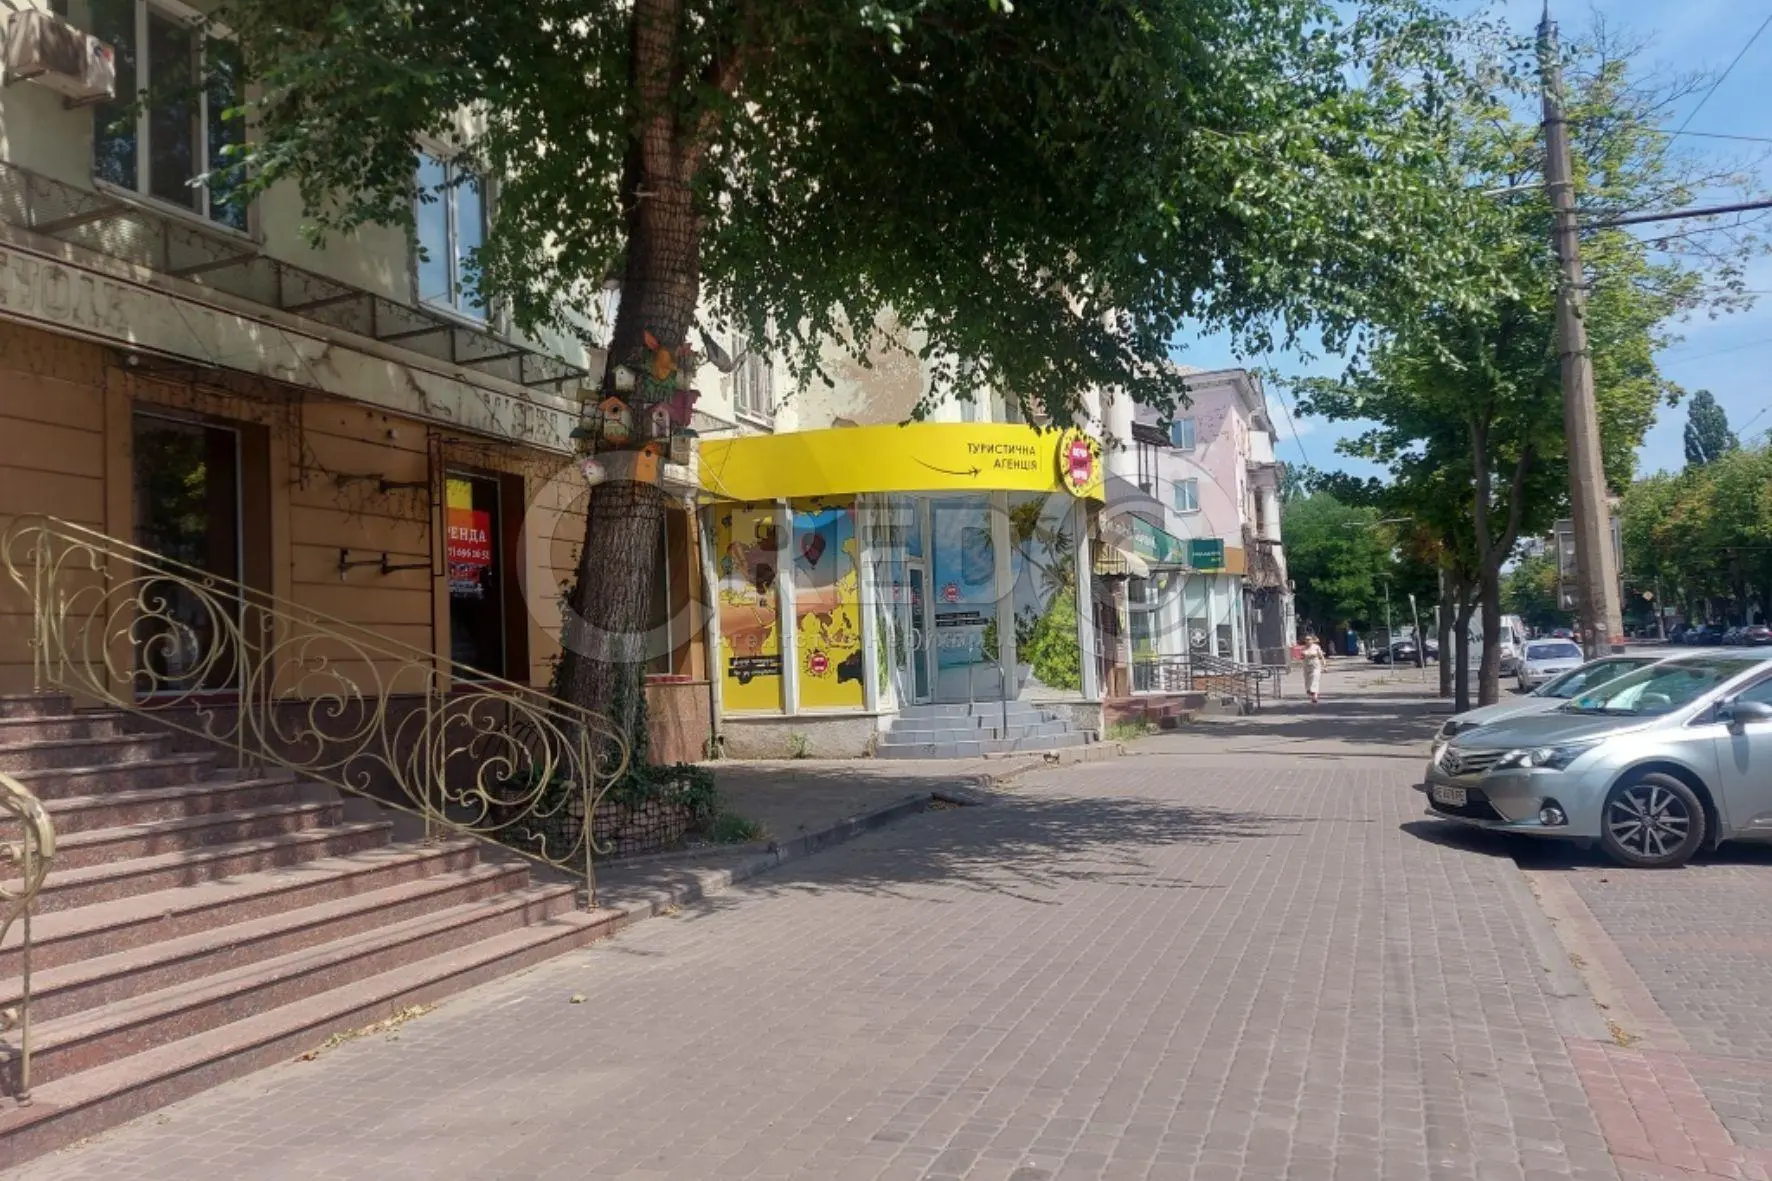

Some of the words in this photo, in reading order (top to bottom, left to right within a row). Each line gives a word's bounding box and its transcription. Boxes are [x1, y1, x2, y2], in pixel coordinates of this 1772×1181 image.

[967, 442, 1036, 456] ТУРИСТИЧНА
[993, 458, 1038, 472] АГЕНЦІЯ
[448, 526, 487, 544] ЕНДА
